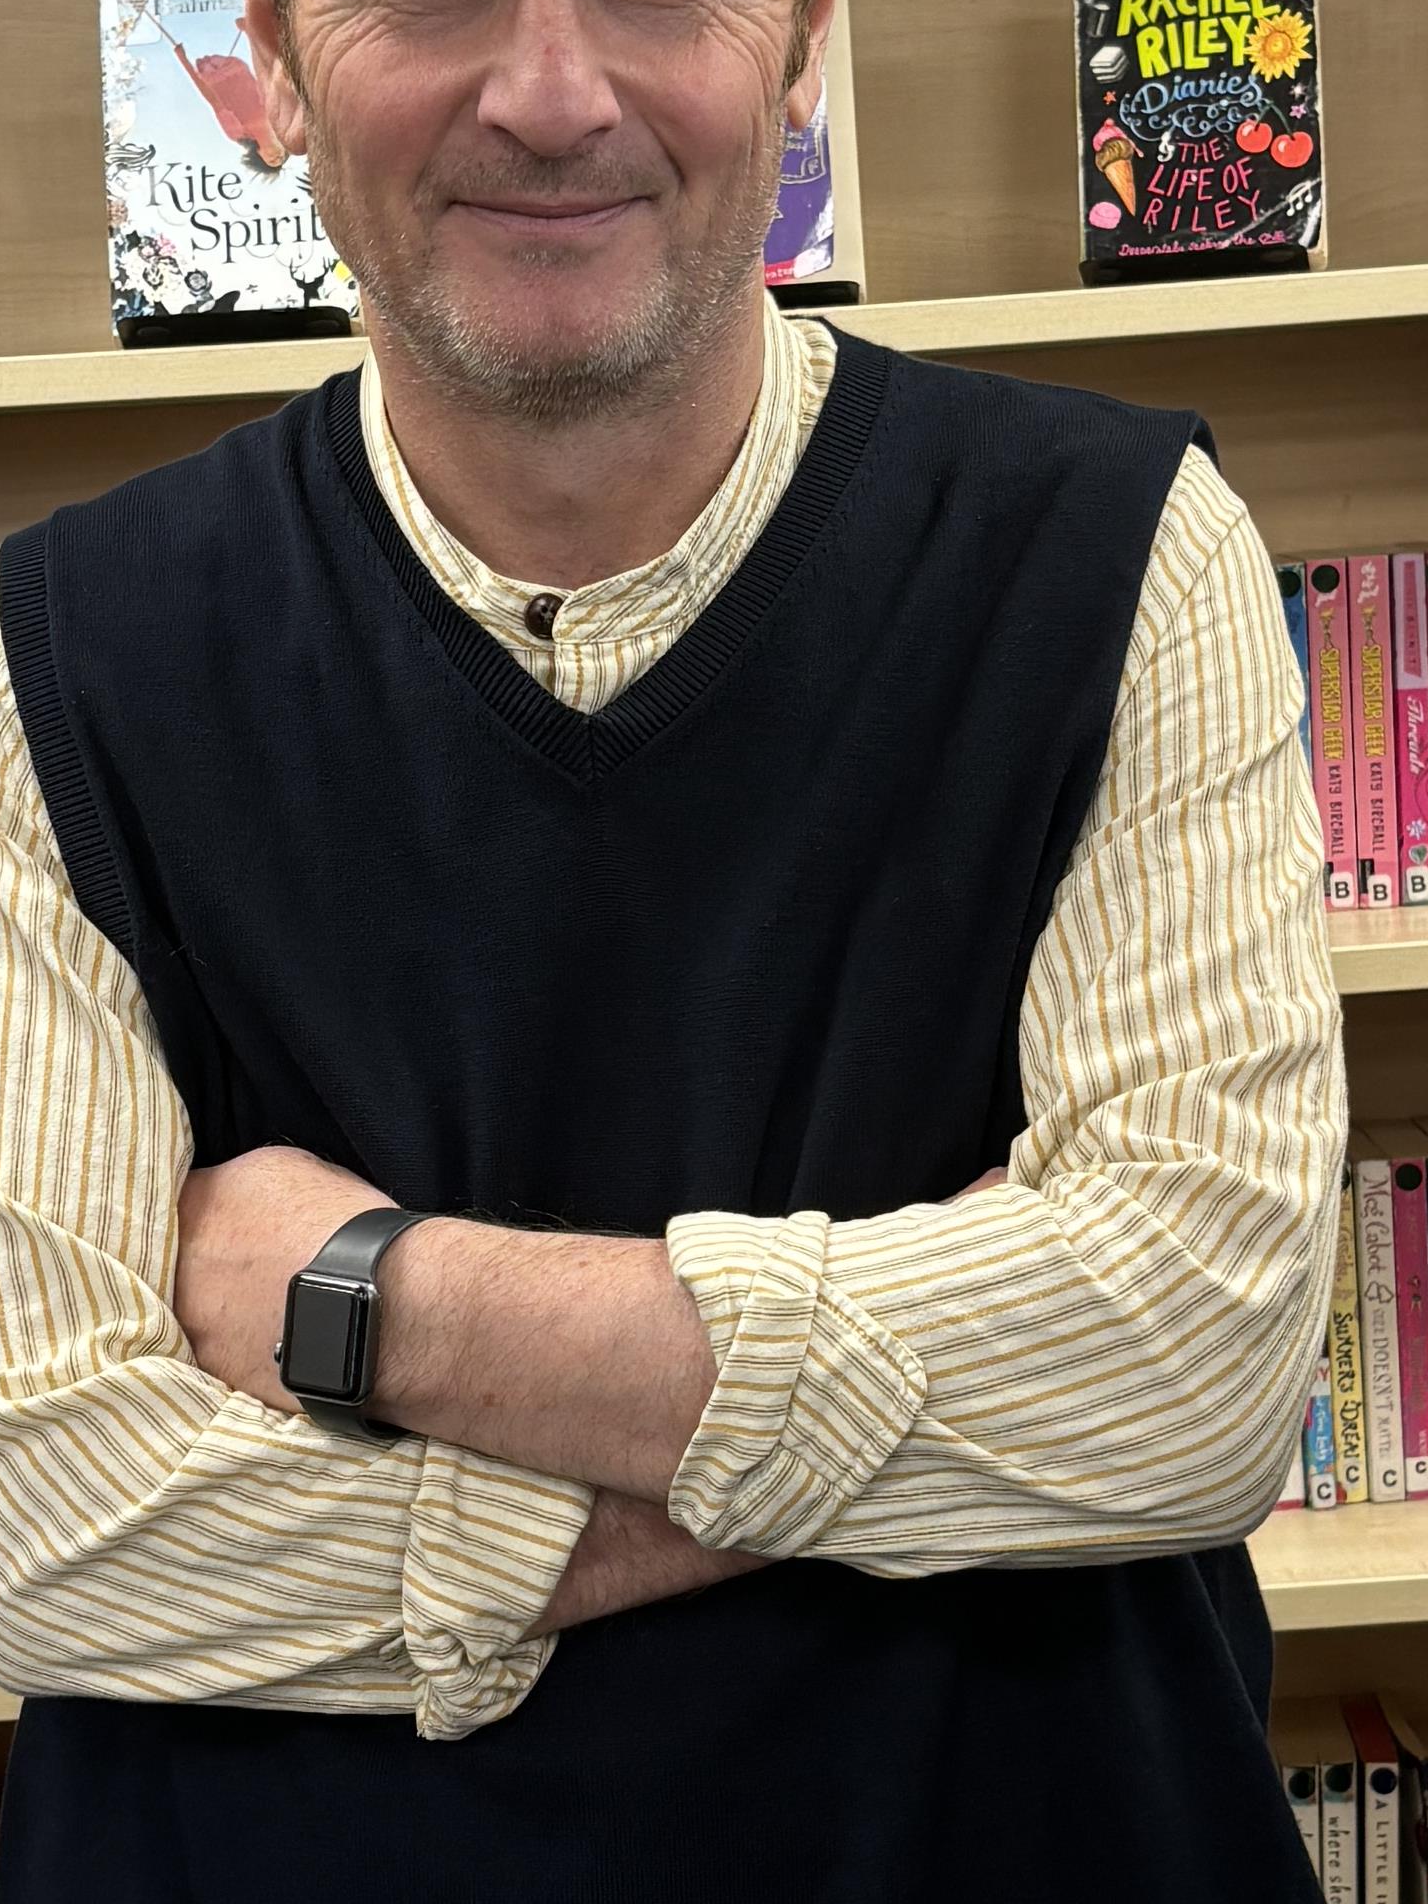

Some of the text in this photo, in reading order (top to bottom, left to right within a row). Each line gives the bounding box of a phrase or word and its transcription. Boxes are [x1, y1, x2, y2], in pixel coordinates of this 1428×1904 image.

[1136, 15, 1251, 78] RILEY
[1123, 73, 1262, 120] Diaries
[1178, 138, 1225, 164] THE
[147, 162, 243, 213] Kite
[1147, 156, 1254, 201] LIFE OF
[191, 196, 326, 264] Spirit
[1143, 189, 1260, 233] RILEY
[1412, 875, 1426, 893] B
[1367, 1224, 1388, 1276] Cabot
[1383, 1470, 1397, 1487] C
[1376, 1800, 1390, 1809] A
